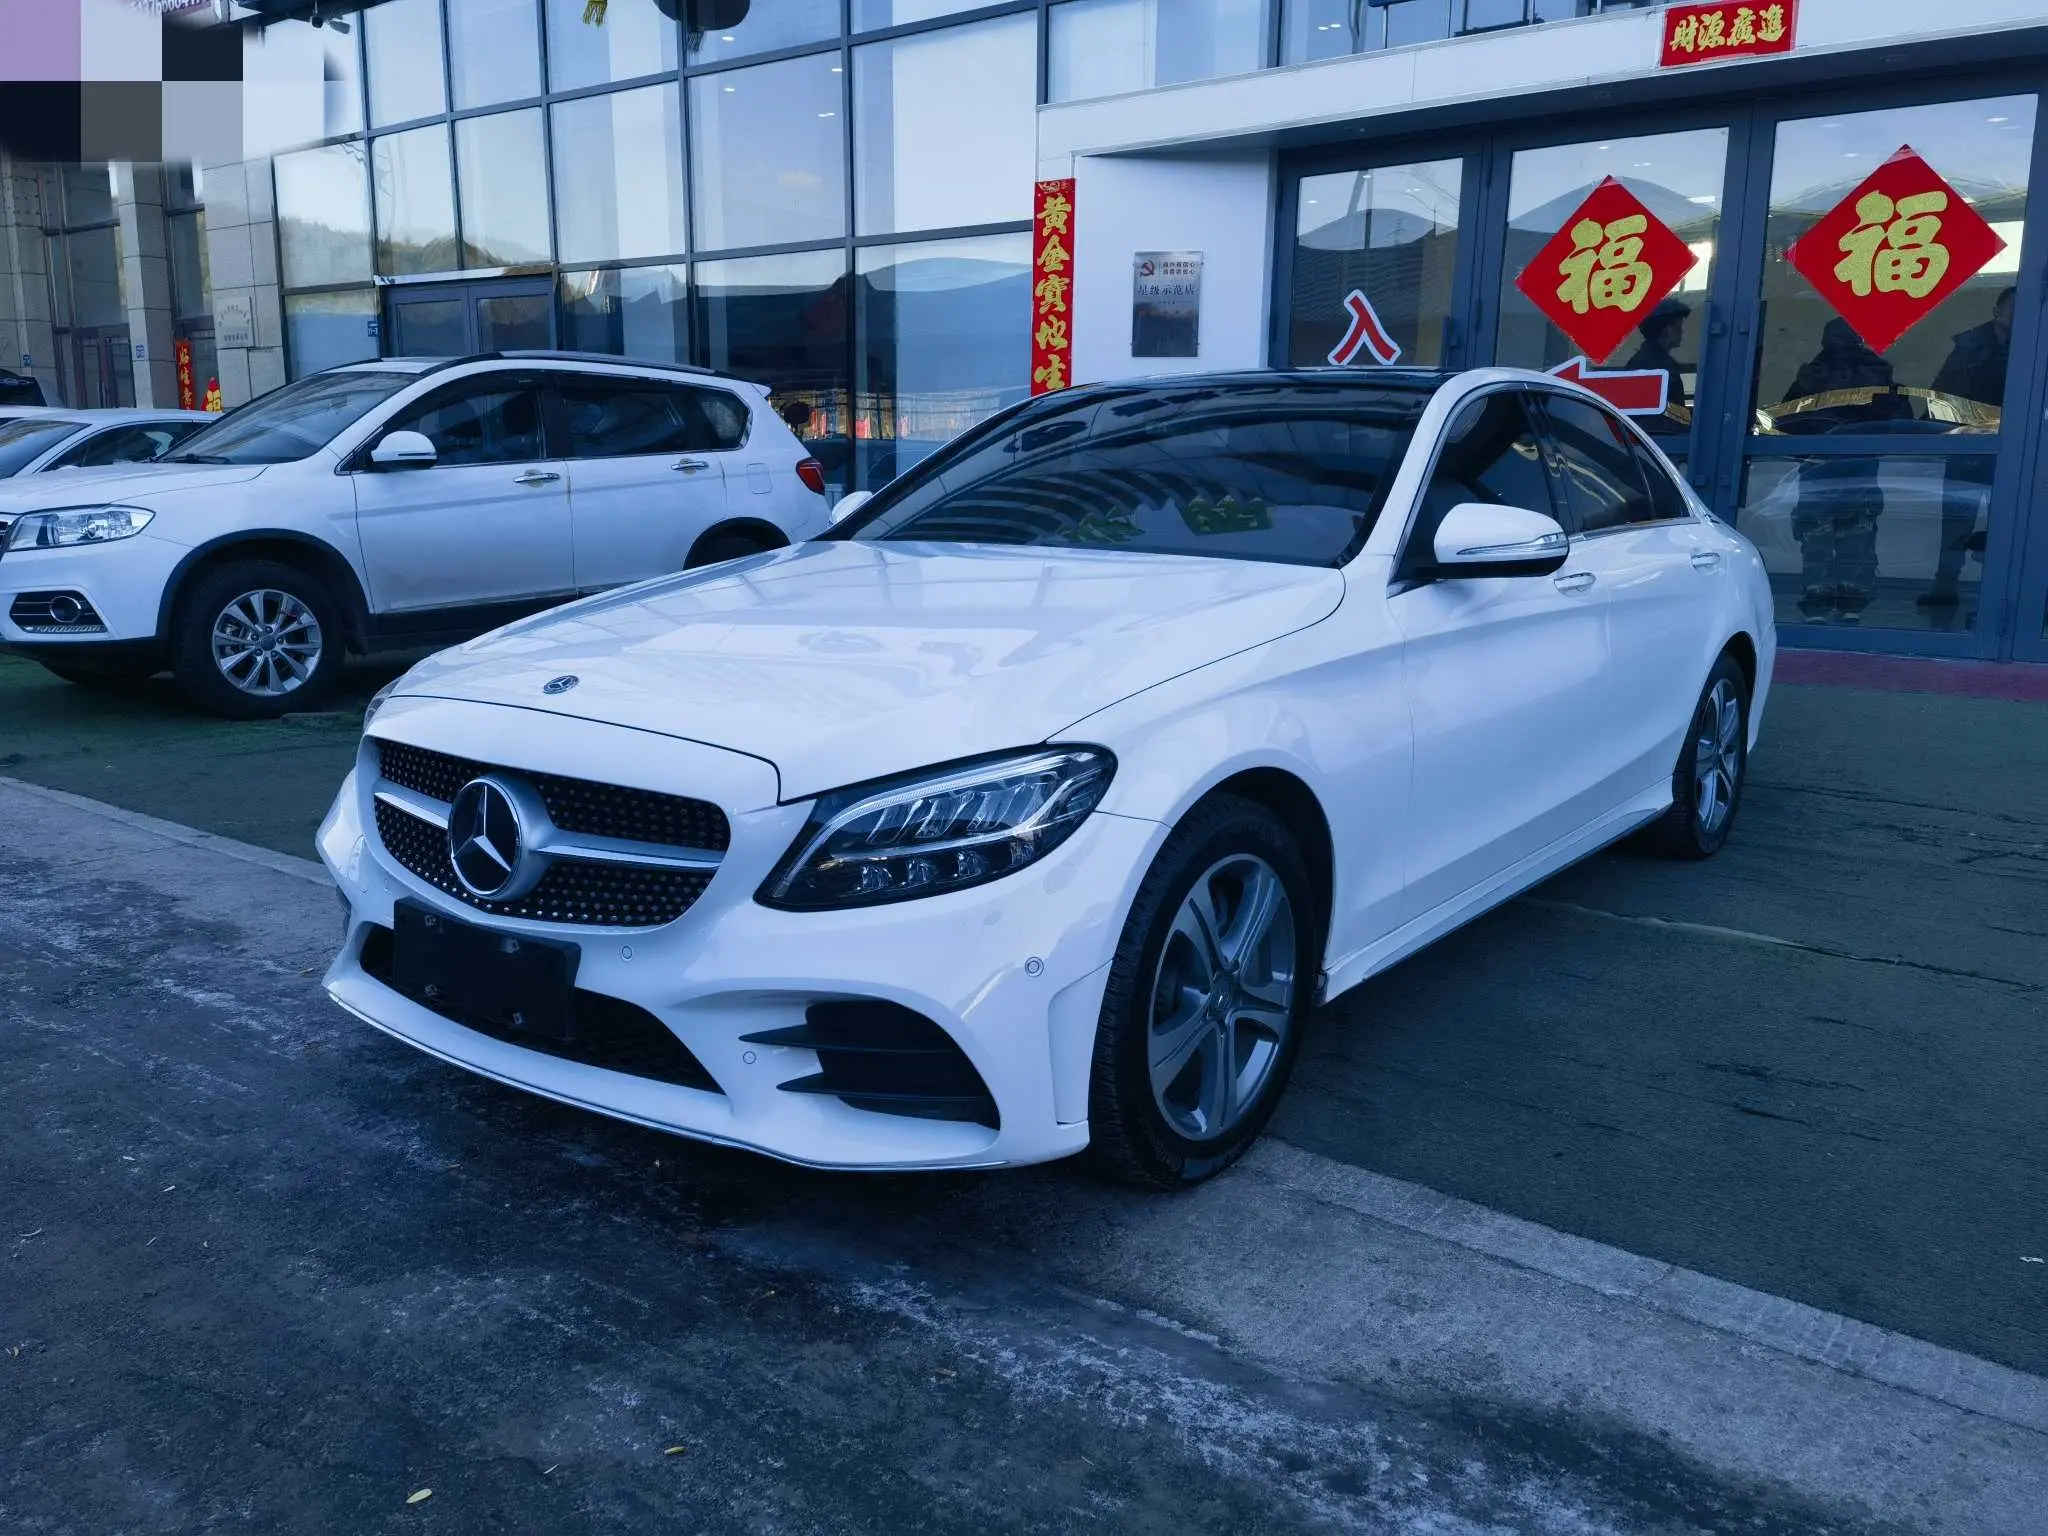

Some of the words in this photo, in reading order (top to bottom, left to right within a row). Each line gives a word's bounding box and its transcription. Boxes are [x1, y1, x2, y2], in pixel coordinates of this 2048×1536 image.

[1557, 213, 1653, 314] 福
[1833, 189, 1950, 299] 福
[1328, 290, 1402, 365] 入
